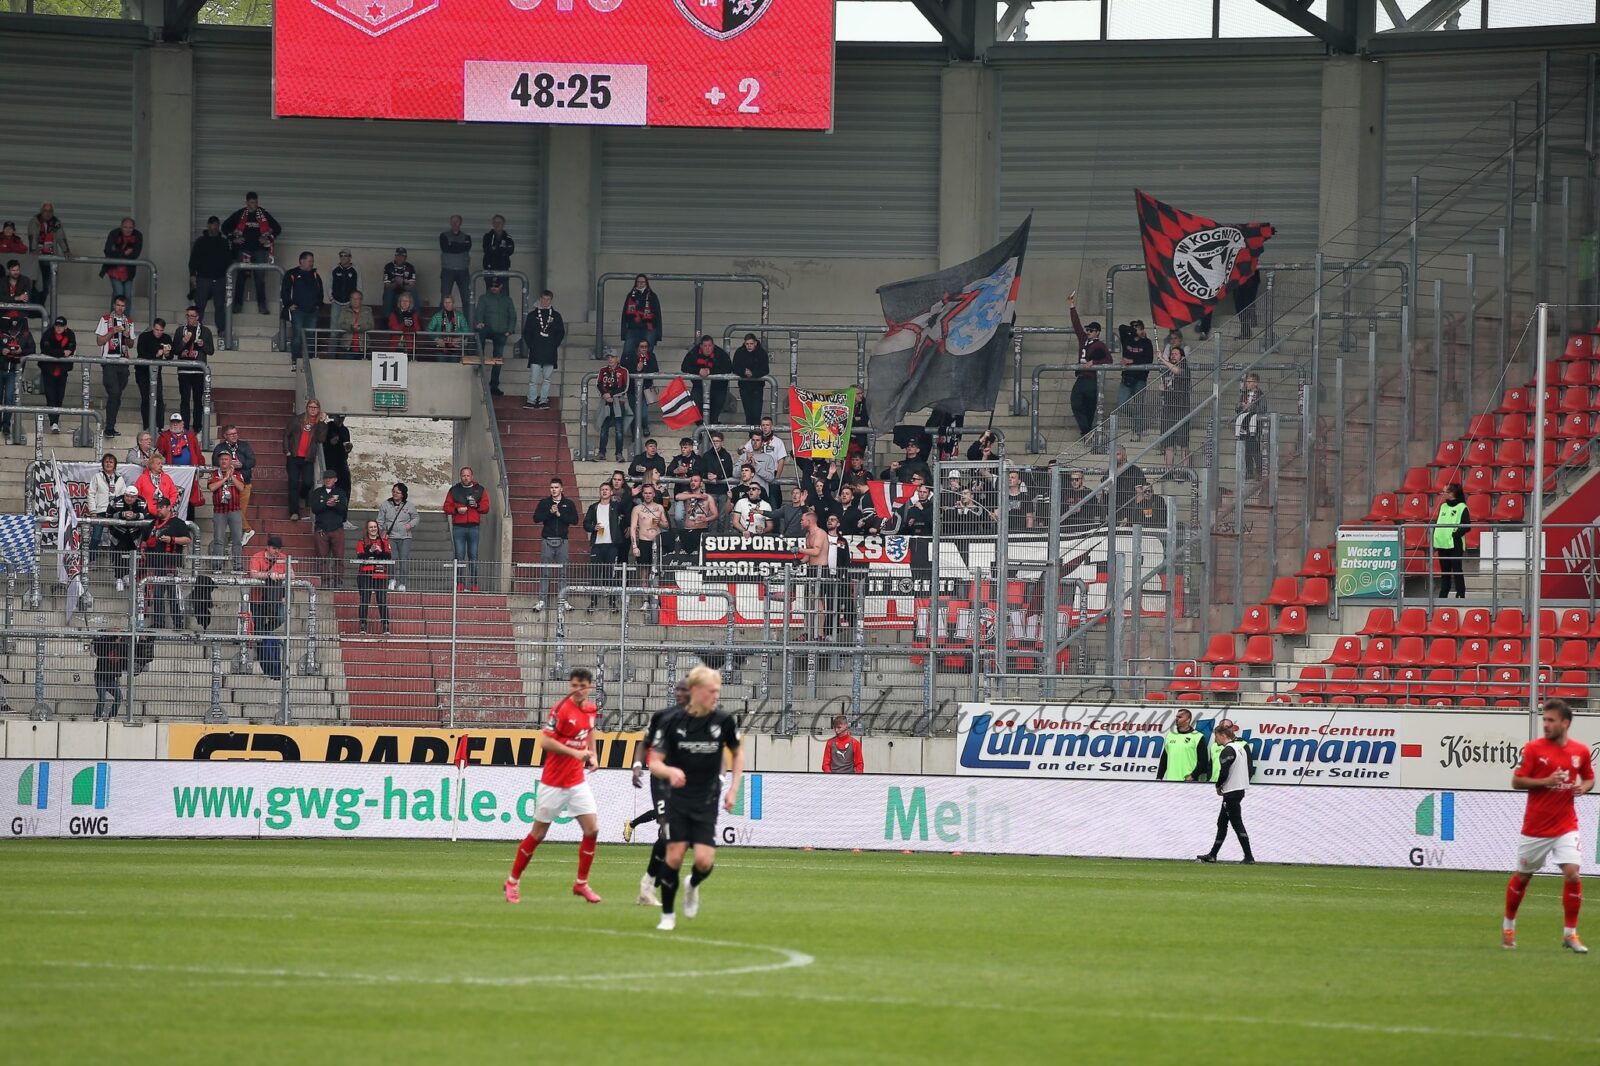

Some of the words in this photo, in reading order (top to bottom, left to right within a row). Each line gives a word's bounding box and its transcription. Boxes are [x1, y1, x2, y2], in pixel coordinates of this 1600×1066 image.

[510, 72, 611, 109] 48:25
[737, 77, 760, 114] 2
[1189, 228, 1241, 243] KOGNITO
[1178, 270, 1220, 298] INGOL
[379, 360, 399, 382] 11
[1347, 546, 1382, 557] Wasser
[1383, 546, 1392, 557] &
[705, 561, 808, 577] INGOLSTD
[1340, 559, 1398, 571] Entsorgung
[1032, 718, 1163, 733] Wohn-Centrum
[1258, 723, 1395, 737] Wohn-Centrum
[960, 714, 1164, 770] Lührmann
[1037, 762, 1061, 771] an
[1071, 760, 1096, 772] der
[1100, 761, 1158, 774] Saline
[1263, 767, 1287, 776] an
[1292, 766, 1325, 777] der
[1328, 767, 1390, 779] Saline
[69, 816, 109, 835] GWG
